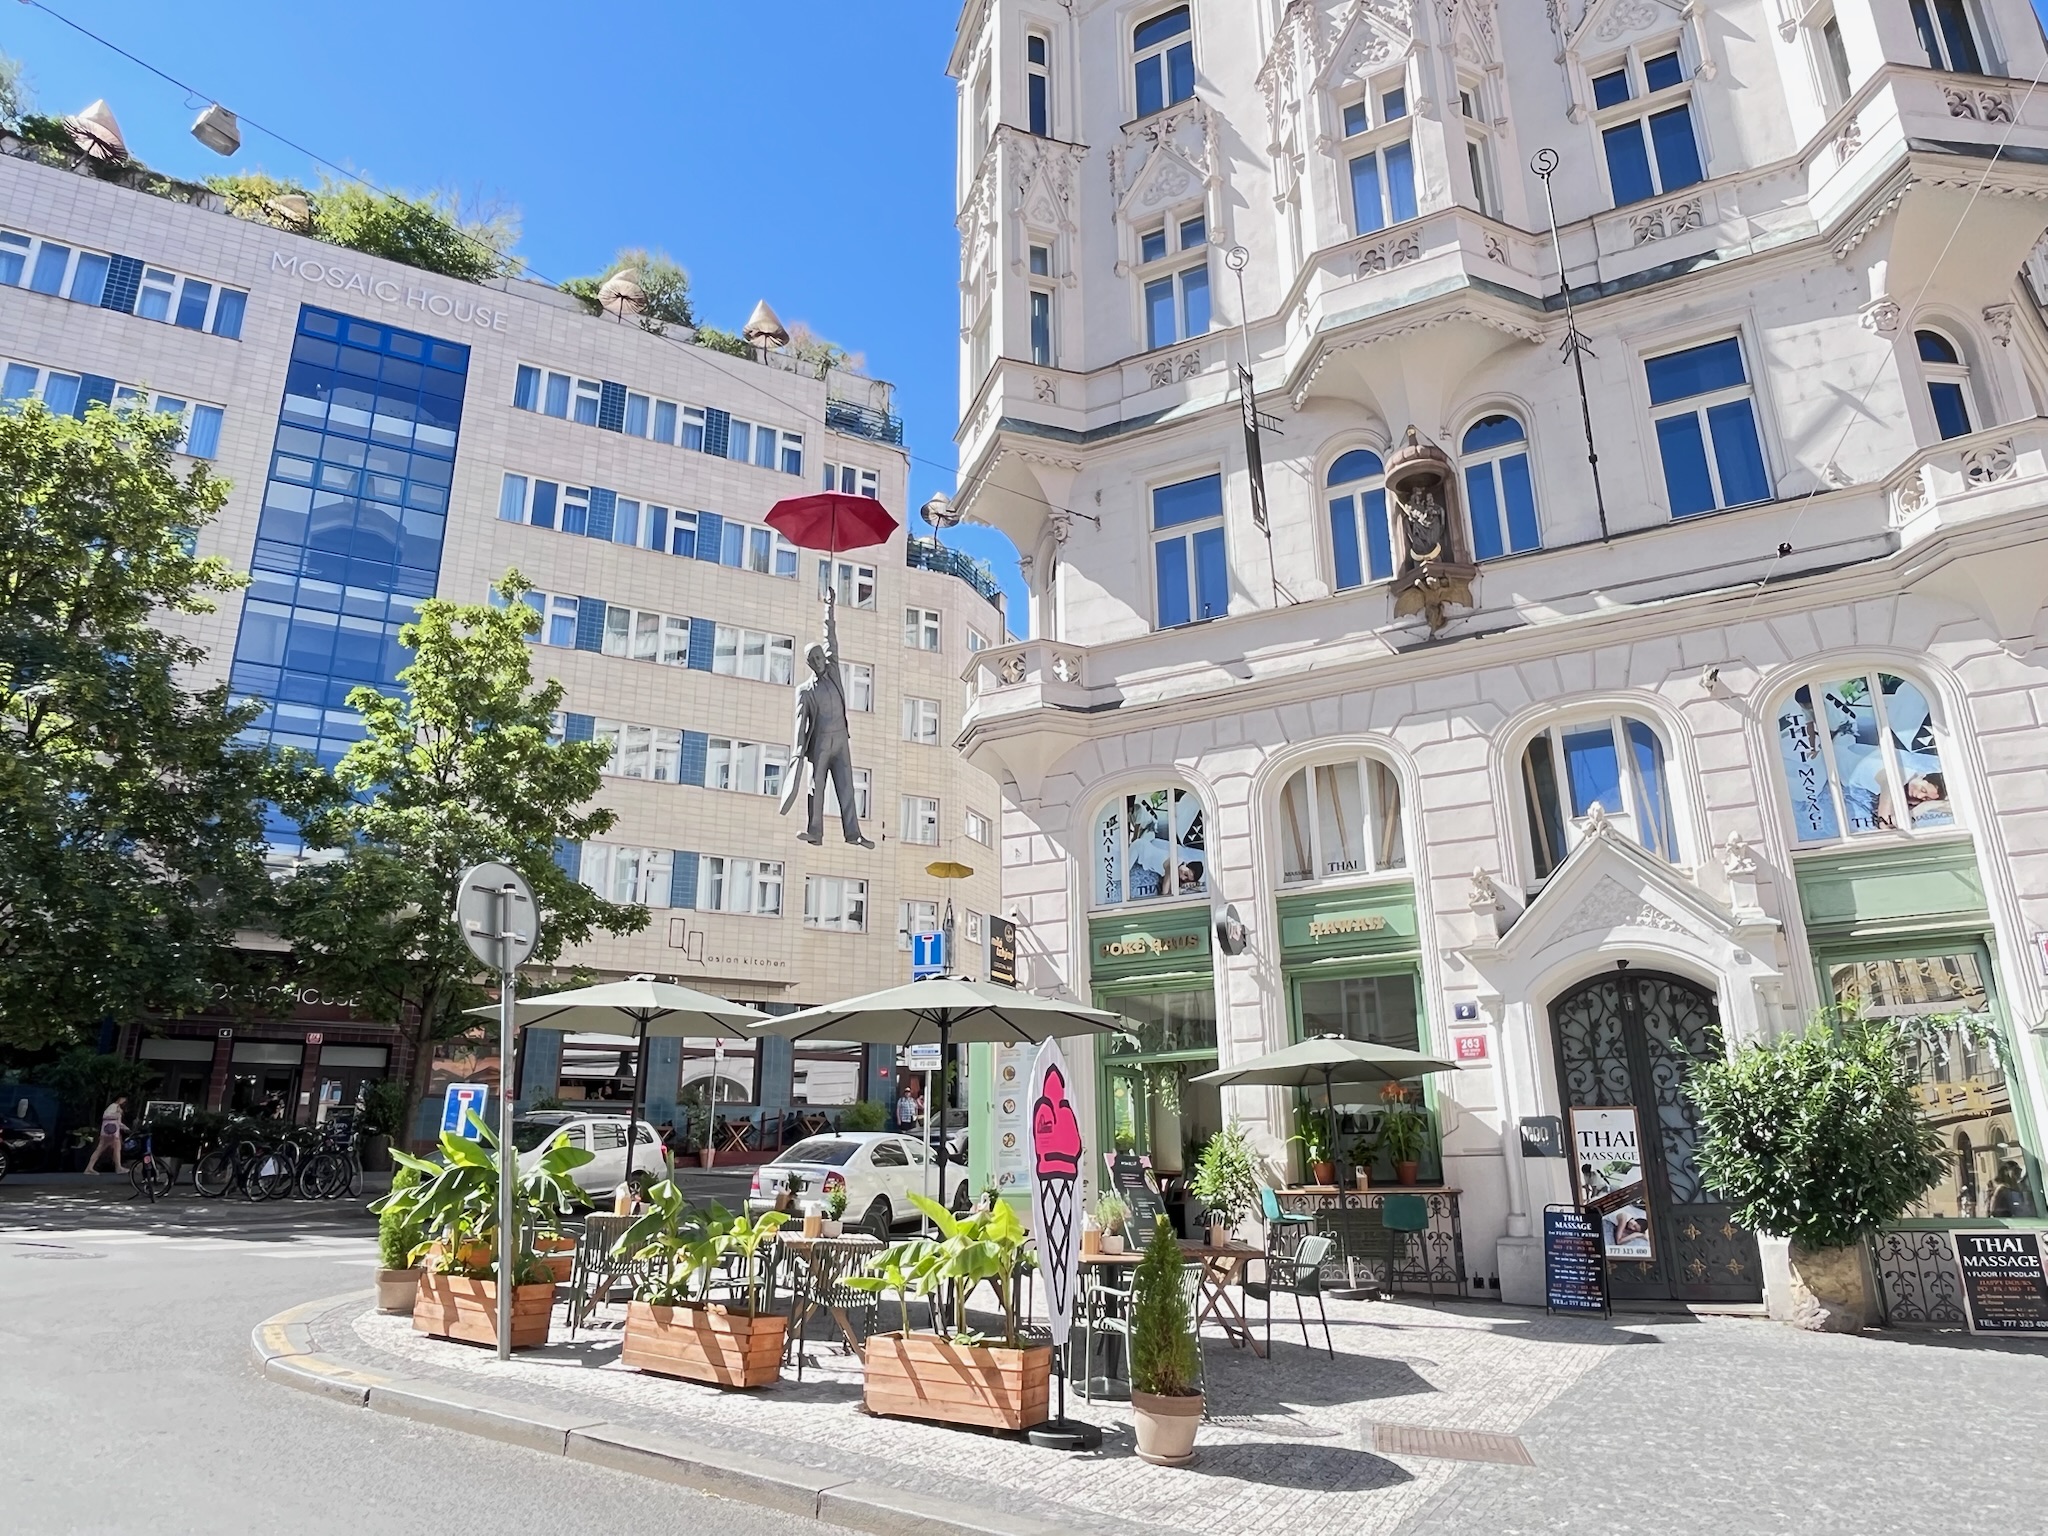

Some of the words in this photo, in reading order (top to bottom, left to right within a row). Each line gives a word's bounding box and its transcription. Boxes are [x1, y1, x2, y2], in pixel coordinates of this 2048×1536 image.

[271, 251, 400, 302] MOSAIC
[406, 286, 509, 332] HOUSE
[1787, 714, 1811, 762] THAI
[1799, 767, 1823, 831] MASSAGE
[1852, 815, 1894, 829] THAI
[1103, 821, 1114, 853] THAI
[1328, 860, 1358, 872] THAI
[1309, 916, 1386, 937] HAWAII
[1100, 939, 1146, 958] POKE
[1151, 935, 1199, 953] HAUS
[743, 955, 786, 968] kitchen
[1461, 1006, 1469, 1017] 2
[1461, 1038, 1480, 1048] 263
[1577, 1131, 1636, 1147] THAI
[1580, 1151, 1639, 1161] MASSAGE
[1563, 1214, 1583, 1222] THAI
[1555, 1222, 1592, 1231] MASSAGE
[1970, 1237, 2024, 1252] THAI
[1963, 1255, 2040, 1267] MASSAGE
